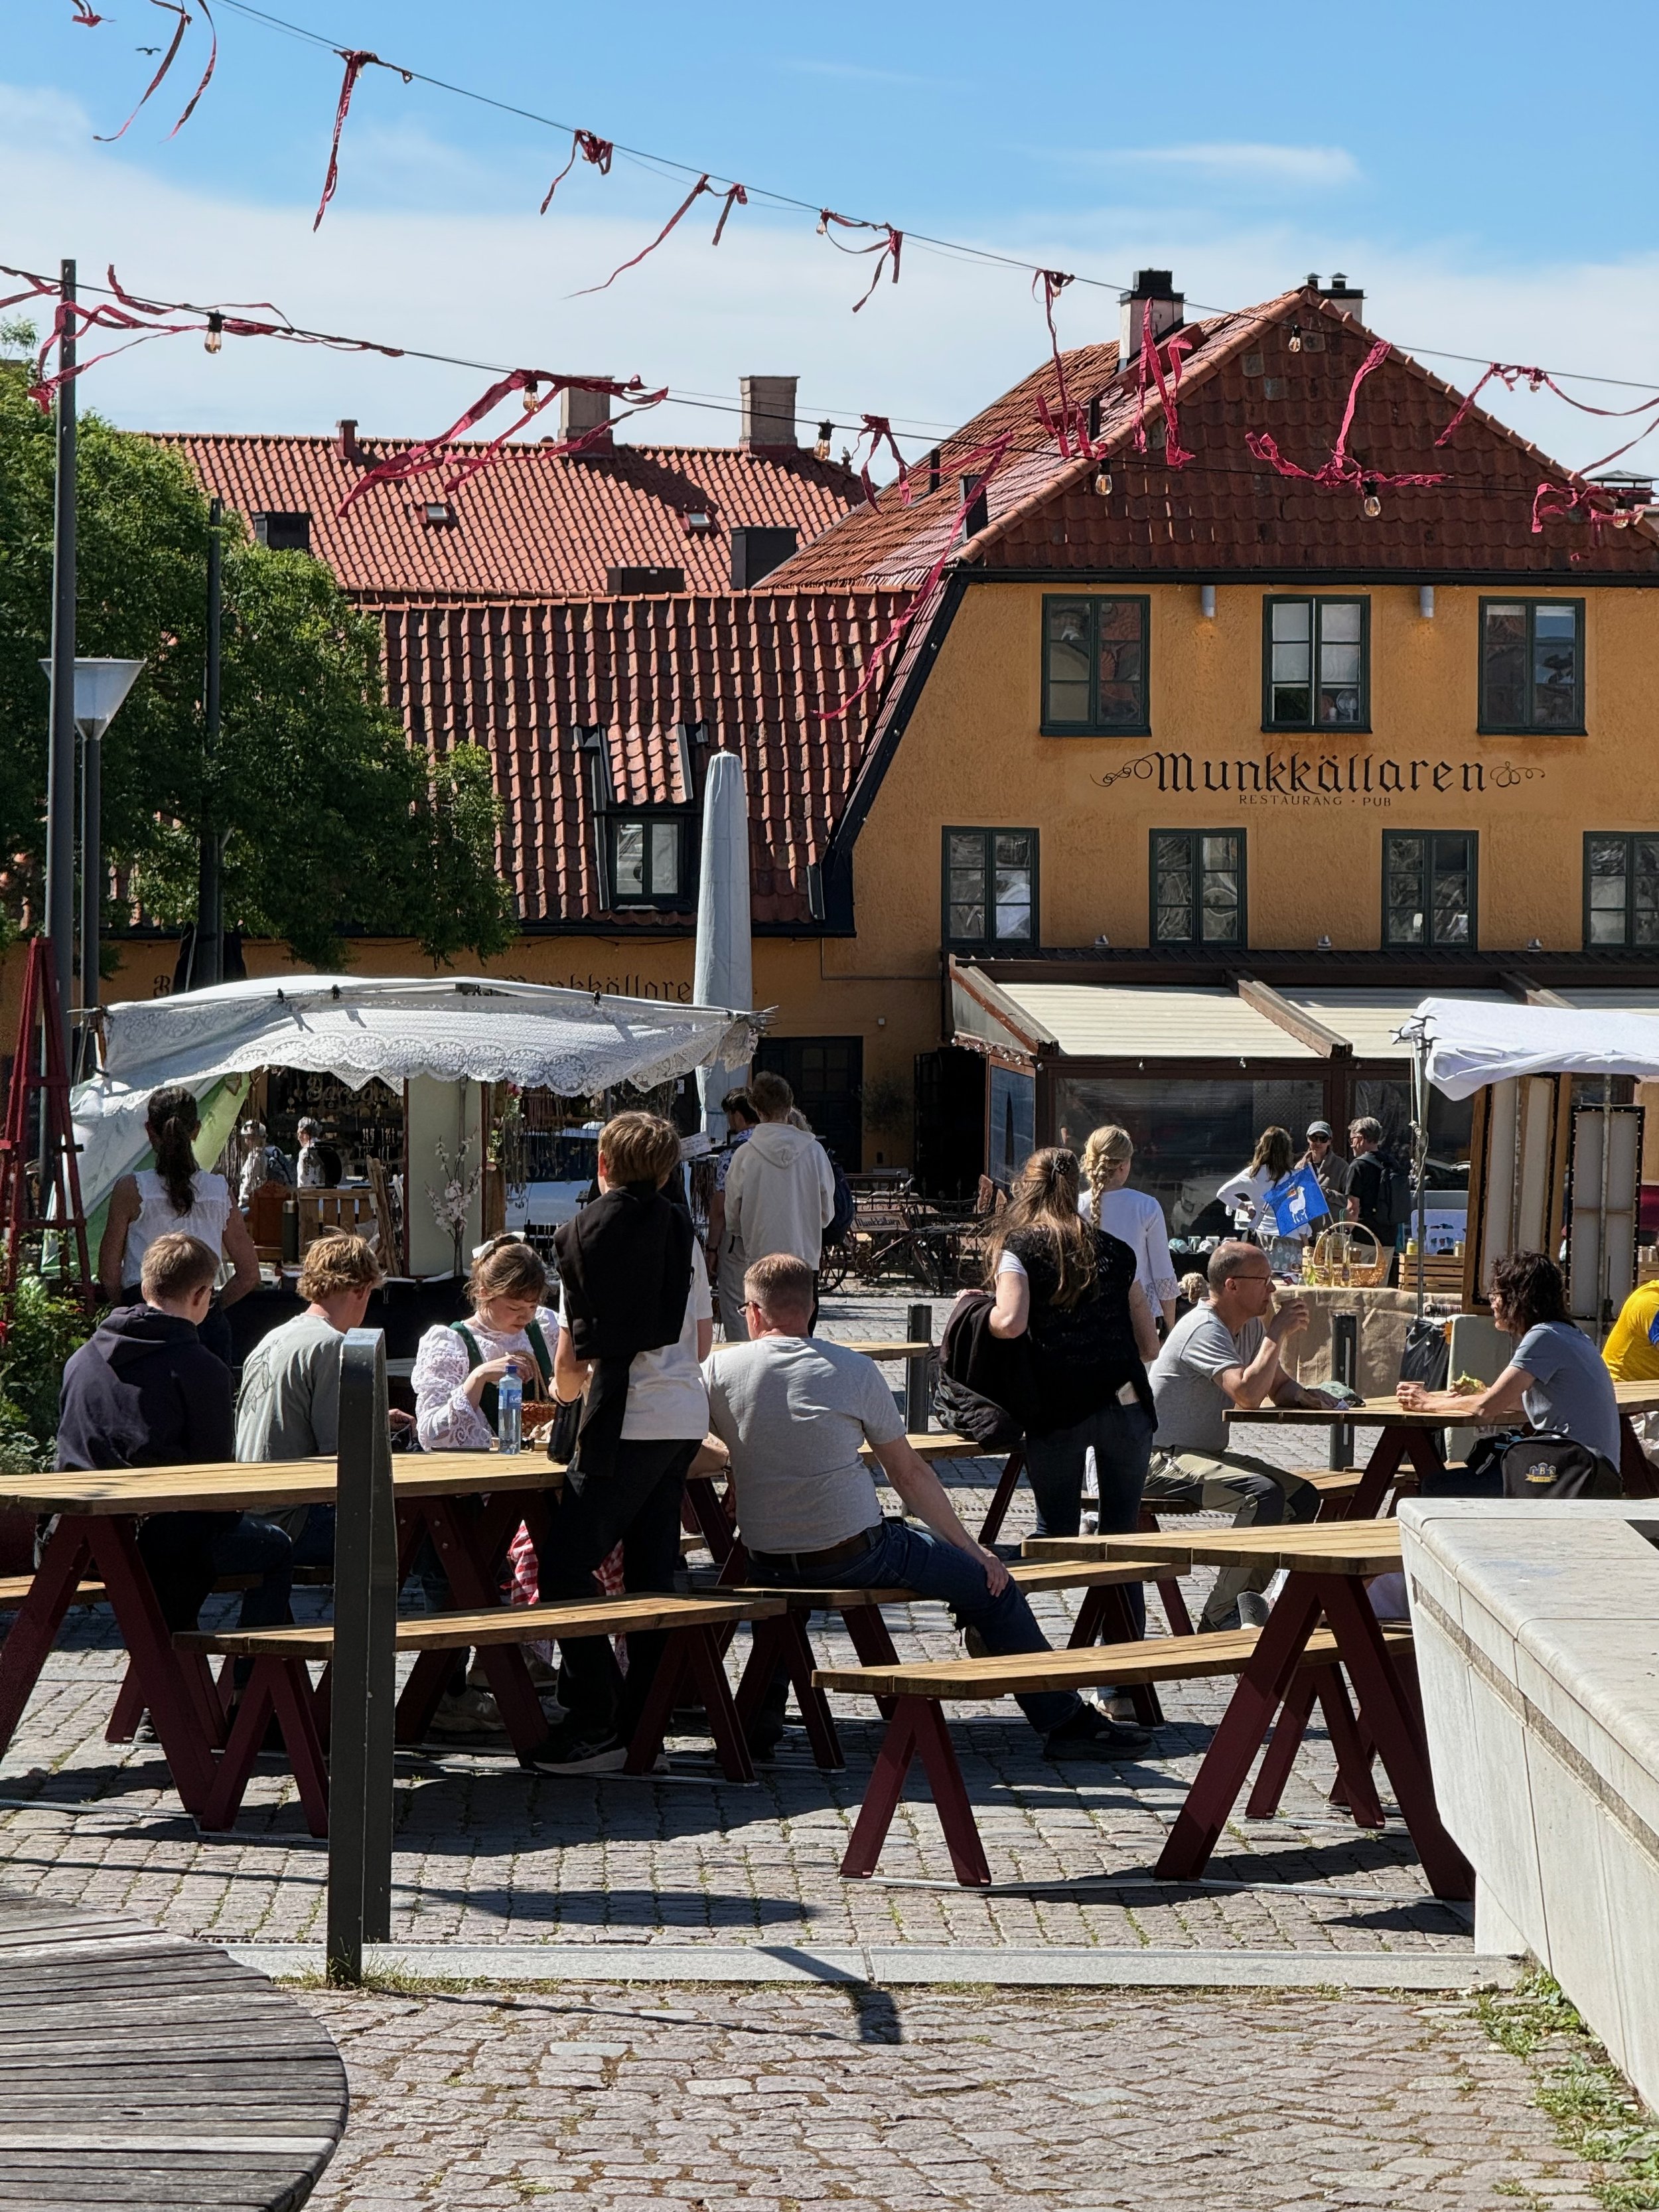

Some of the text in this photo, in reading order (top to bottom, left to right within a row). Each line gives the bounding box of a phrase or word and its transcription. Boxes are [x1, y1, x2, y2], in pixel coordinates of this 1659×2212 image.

[1153, 750, 1488, 796] Munkkällaren
[1238, 794, 1392, 808] RESTAURANG PUB
